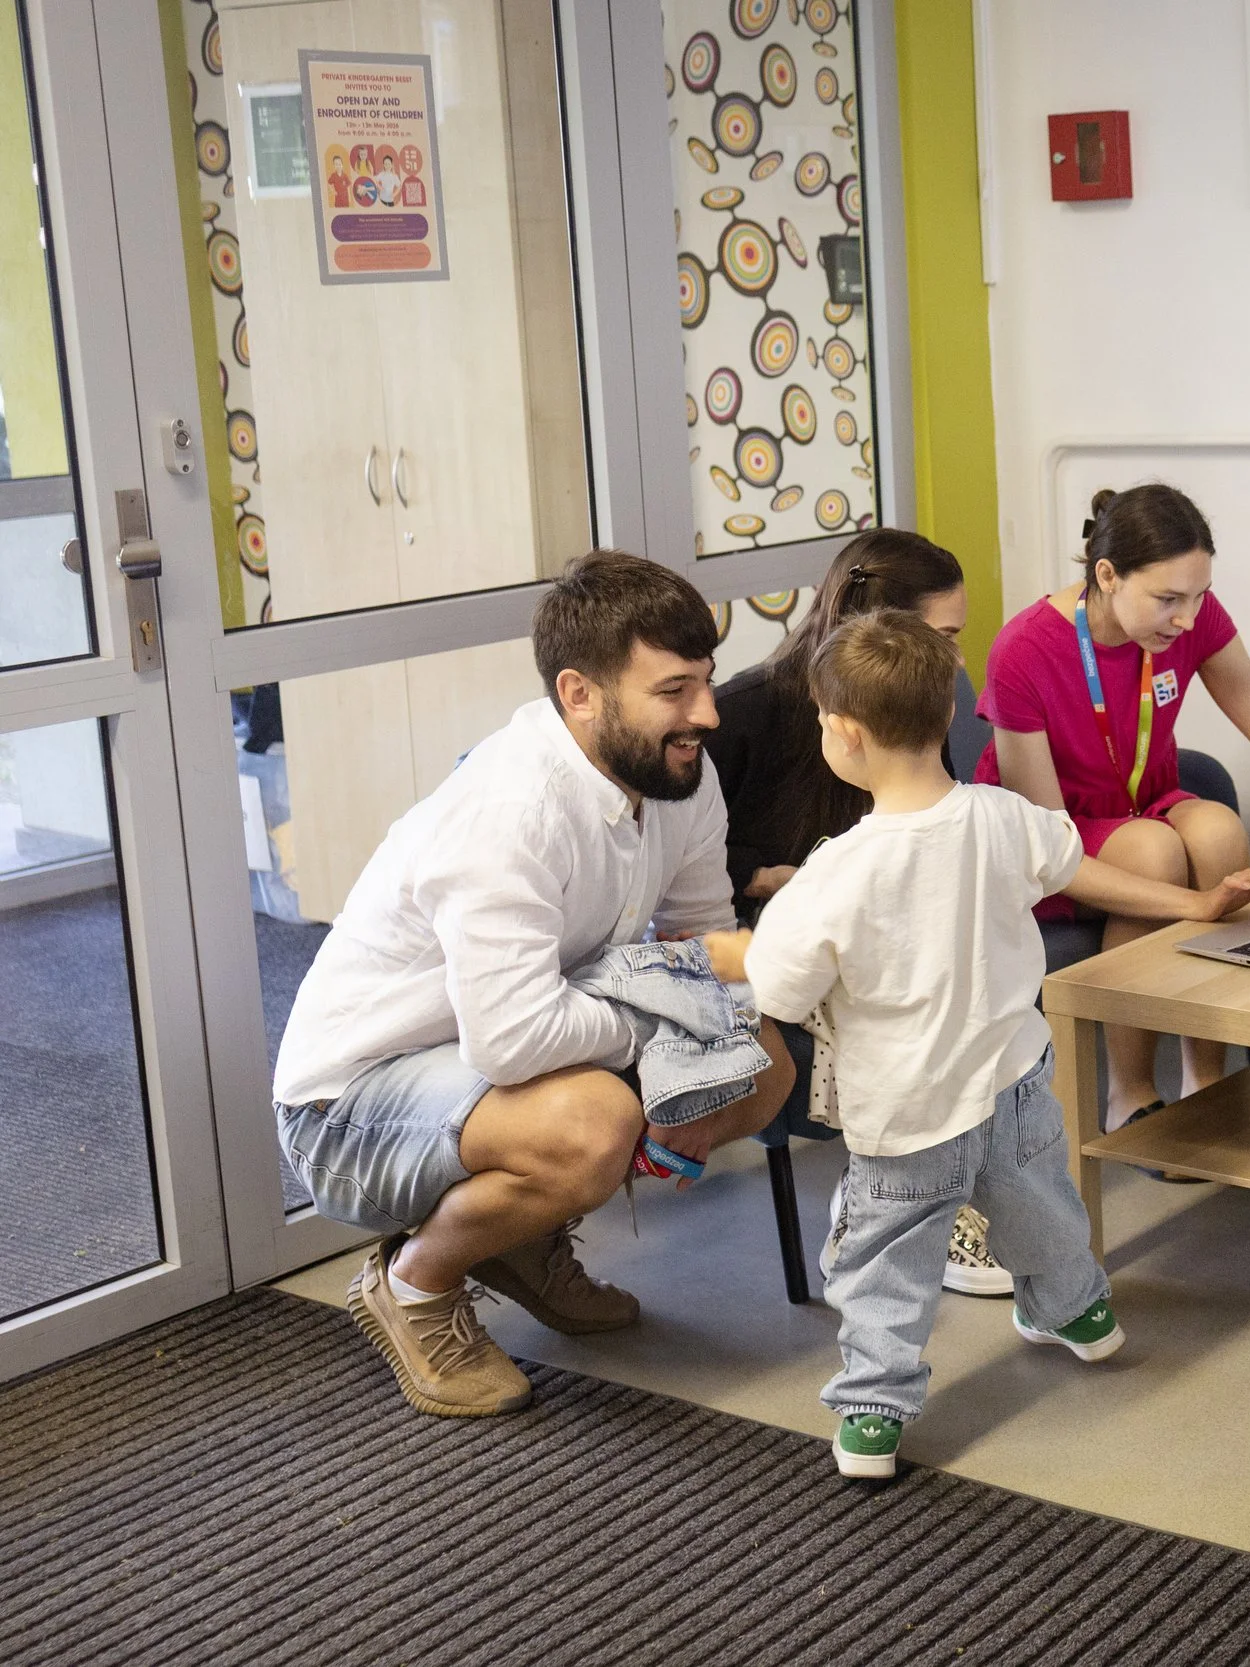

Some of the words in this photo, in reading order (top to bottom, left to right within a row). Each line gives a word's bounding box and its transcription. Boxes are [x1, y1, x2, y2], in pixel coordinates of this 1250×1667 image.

[348, 74, 394, 82] KINDERGARTEN
[336, 96, 360, 105] OPEN
[362, 96, 380, 106] DAY
[382, 97, 400, 106] AND
[317, 108, 368, 118] ENROLMENT
[370, 110, 380, 119] OF
[382, 110, 424, 120] CHILDREN
[374, 122, 384, 130] May
